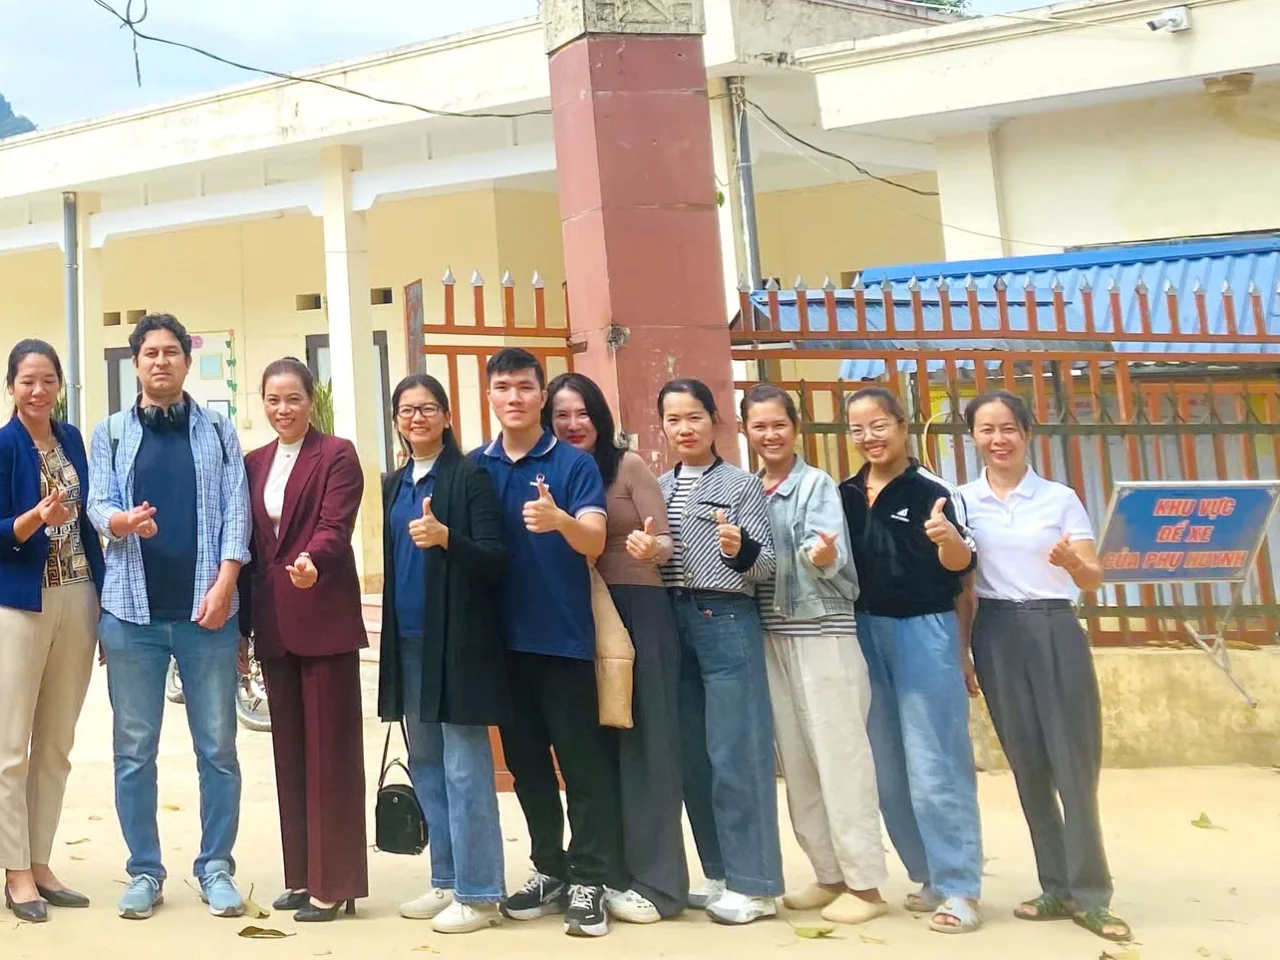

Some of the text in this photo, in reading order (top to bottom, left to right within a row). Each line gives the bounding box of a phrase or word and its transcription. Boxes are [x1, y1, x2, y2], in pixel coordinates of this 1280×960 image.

[1153, 496, 1236, 520] KHU VỰC
[1184, 525, 1215, 543] XE
